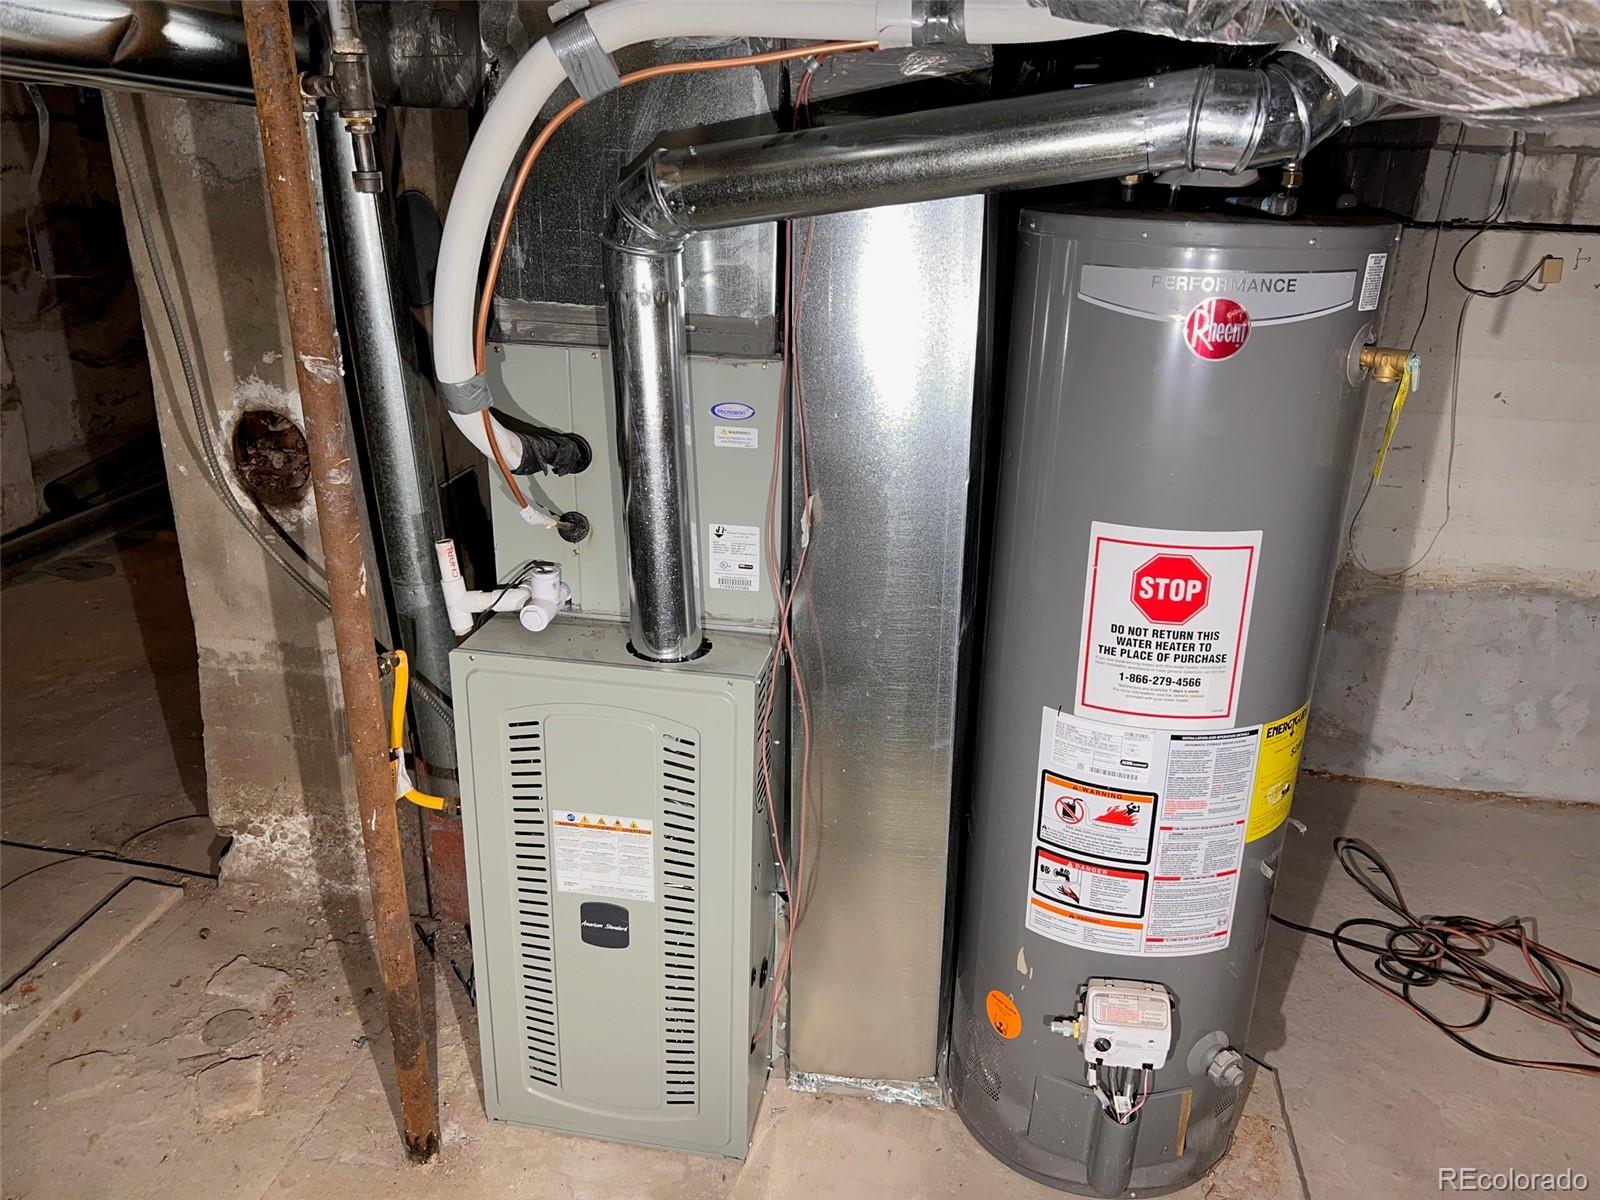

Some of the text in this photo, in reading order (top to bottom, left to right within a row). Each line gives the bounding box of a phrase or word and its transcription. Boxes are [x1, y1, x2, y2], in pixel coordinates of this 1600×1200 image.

[1152, 275, 1297, 292] PERFORMANCE
[1188, 300, 1247, 351] Rheem
[1139, 576, 1202, 602] STOP
[1111, 624, 1220, 641] DO NOT RETURN THIS
[1116, 636, 1212, 652] WATER HEATER TO
[1098, 645, 1117, 657] THE
[1120, 648, 1153, 661] PLACE
[1156, 652, 1170, 663] OF
[1173, 654, 1227, 664] PURCHASE
[1119, 672, 1201, 687] 1-866-279-4566
[1082, 787, 1123, 800] WARNING
[1075, 864, 1108, 875] DANGER
